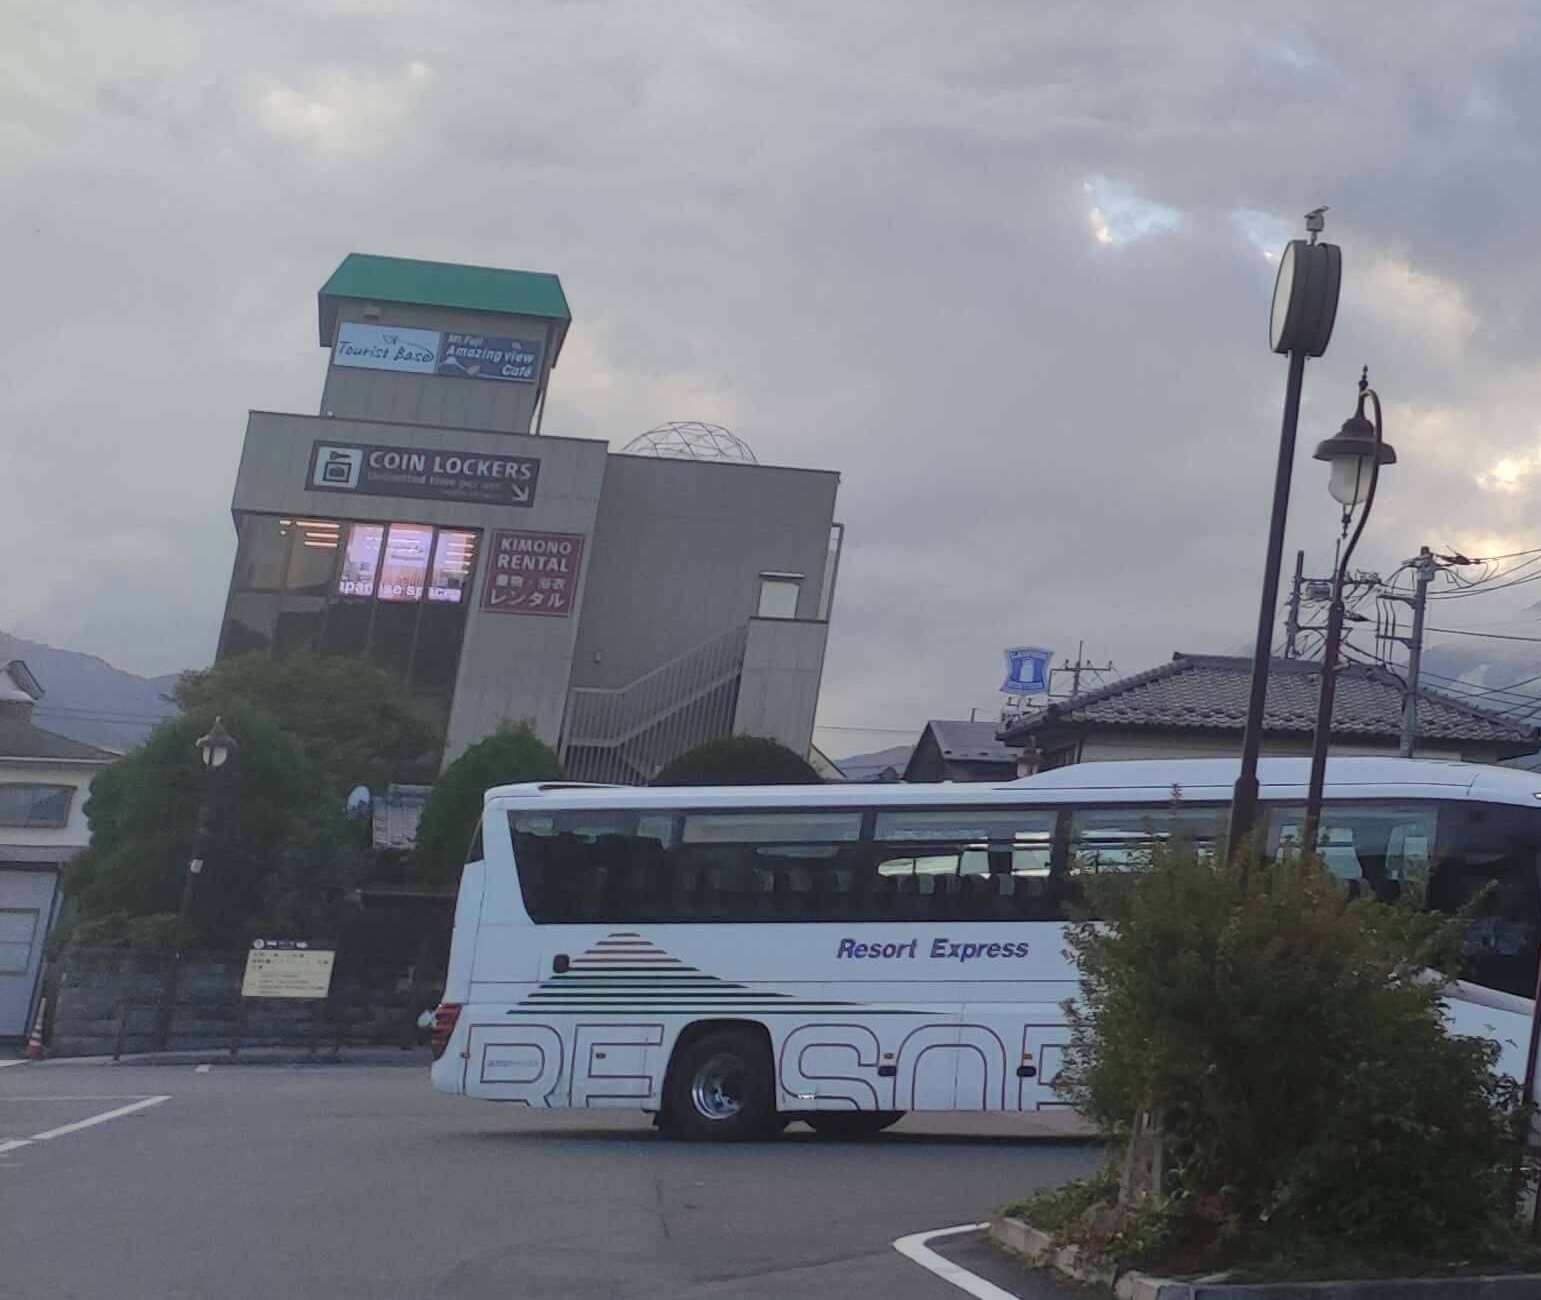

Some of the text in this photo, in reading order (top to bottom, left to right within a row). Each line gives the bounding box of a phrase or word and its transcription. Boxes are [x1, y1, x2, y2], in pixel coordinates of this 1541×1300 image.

[337, 341, 434, 363] Tourist Base
[446, 345, 502, 363] Amazing
[369, 451, 532, 480] COIN LOCKERS
[501, 537, 572, 555] KIMONO
[499, 554, 569, 573] RENTAL
[490, 588, 565, 608] レンタル
[837, 938, 1029, 963] Resort Express
